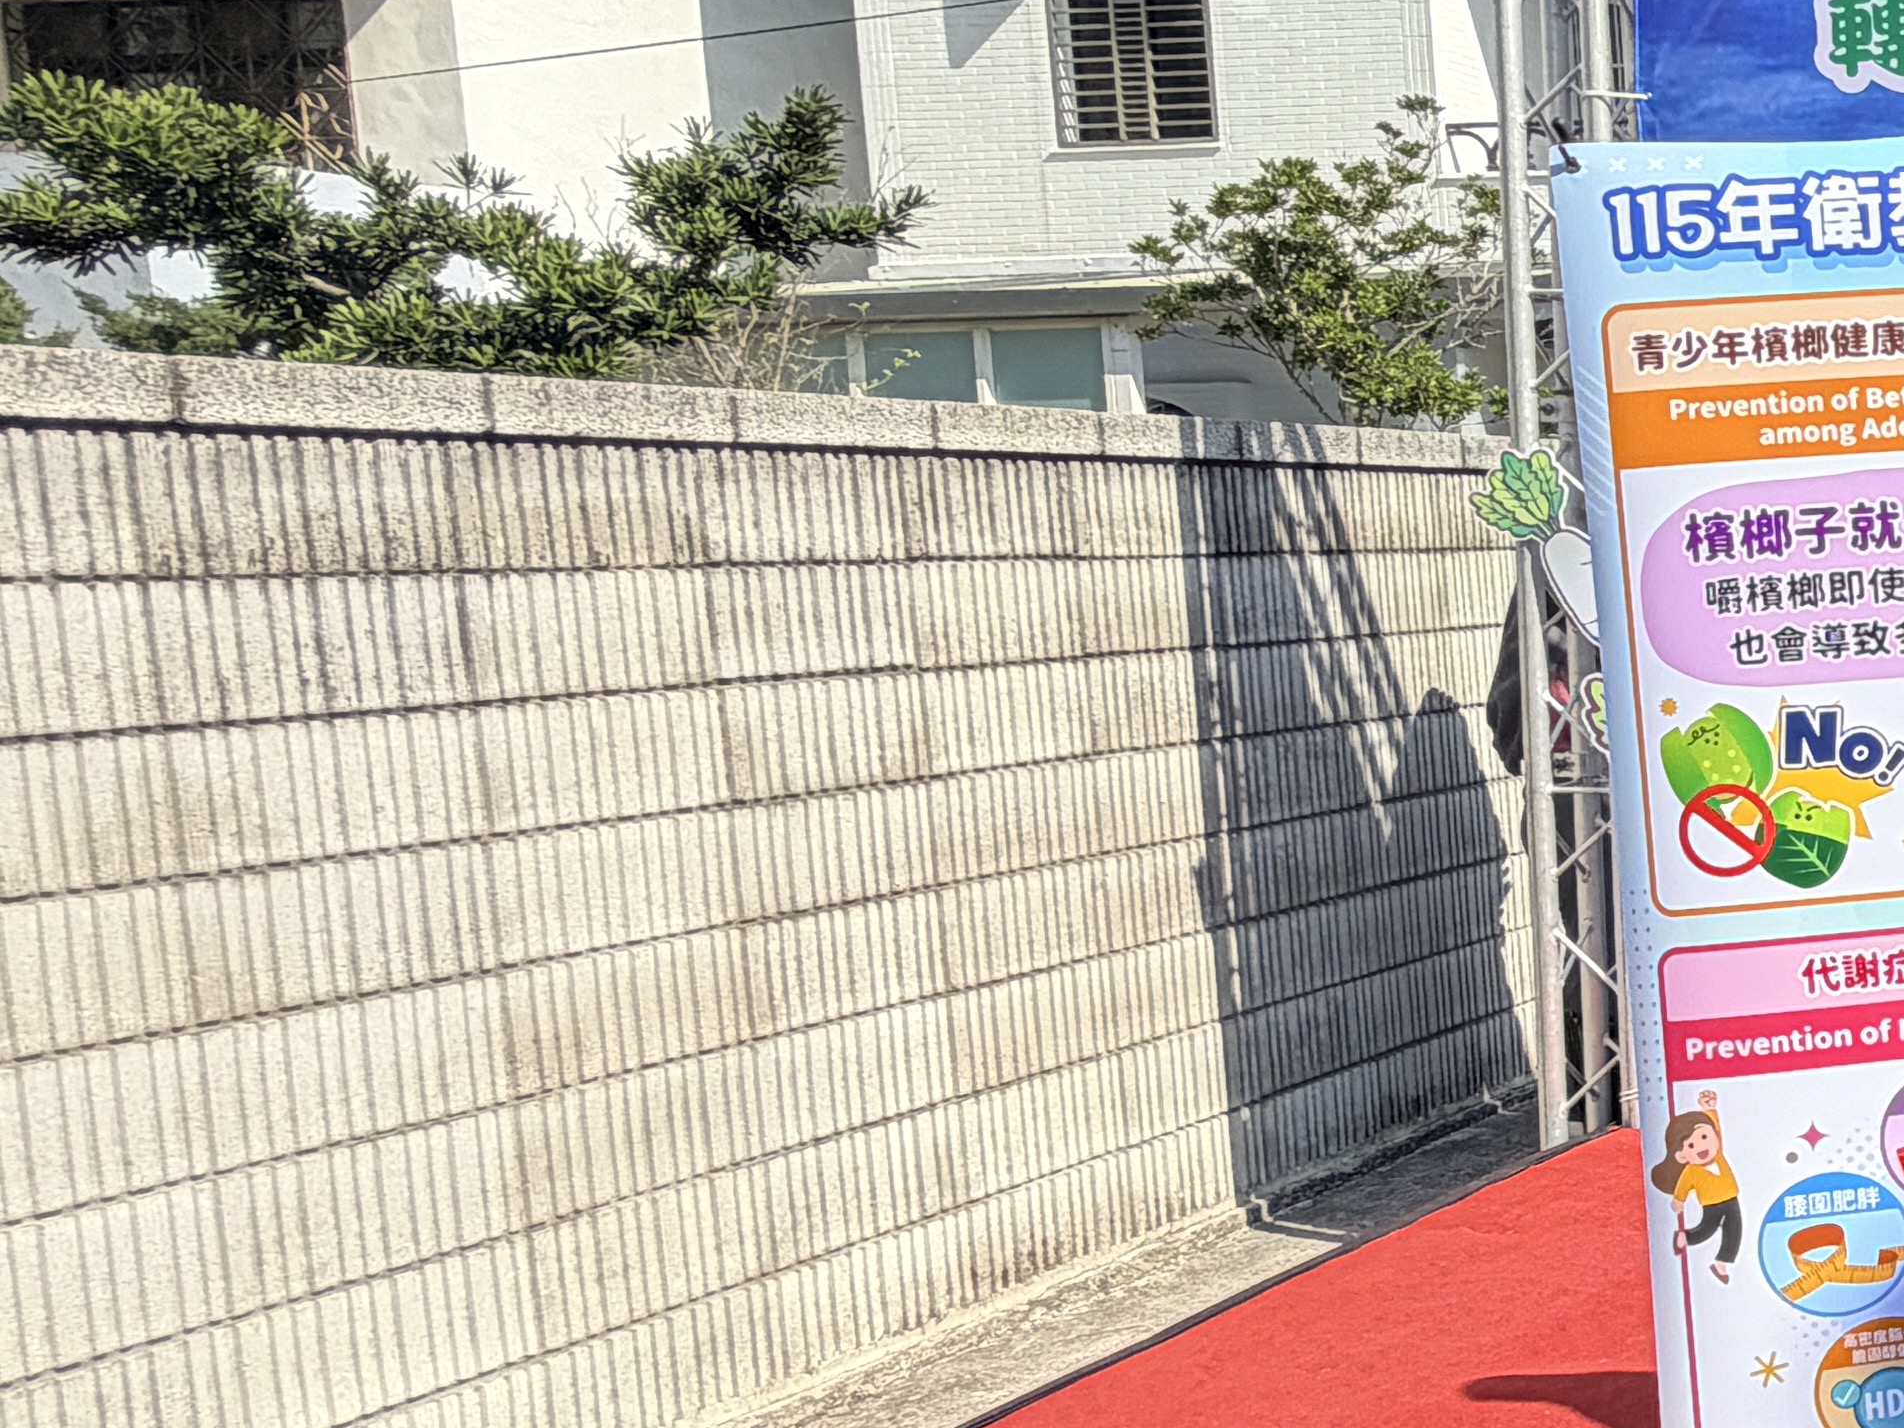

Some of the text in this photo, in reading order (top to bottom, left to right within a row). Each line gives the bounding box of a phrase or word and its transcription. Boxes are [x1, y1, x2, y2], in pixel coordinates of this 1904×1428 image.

[1669, 394, 1826, 421] Prevention
[1831, 390, 1859, 411] of
[1759, 419, 1856, 447] among
[1686, 1028, 1852, 1062] Prevention
[1860, 1022, 1893, 1046] of
[1783, 1186, 1881, 1219] 腰圍肥胖
